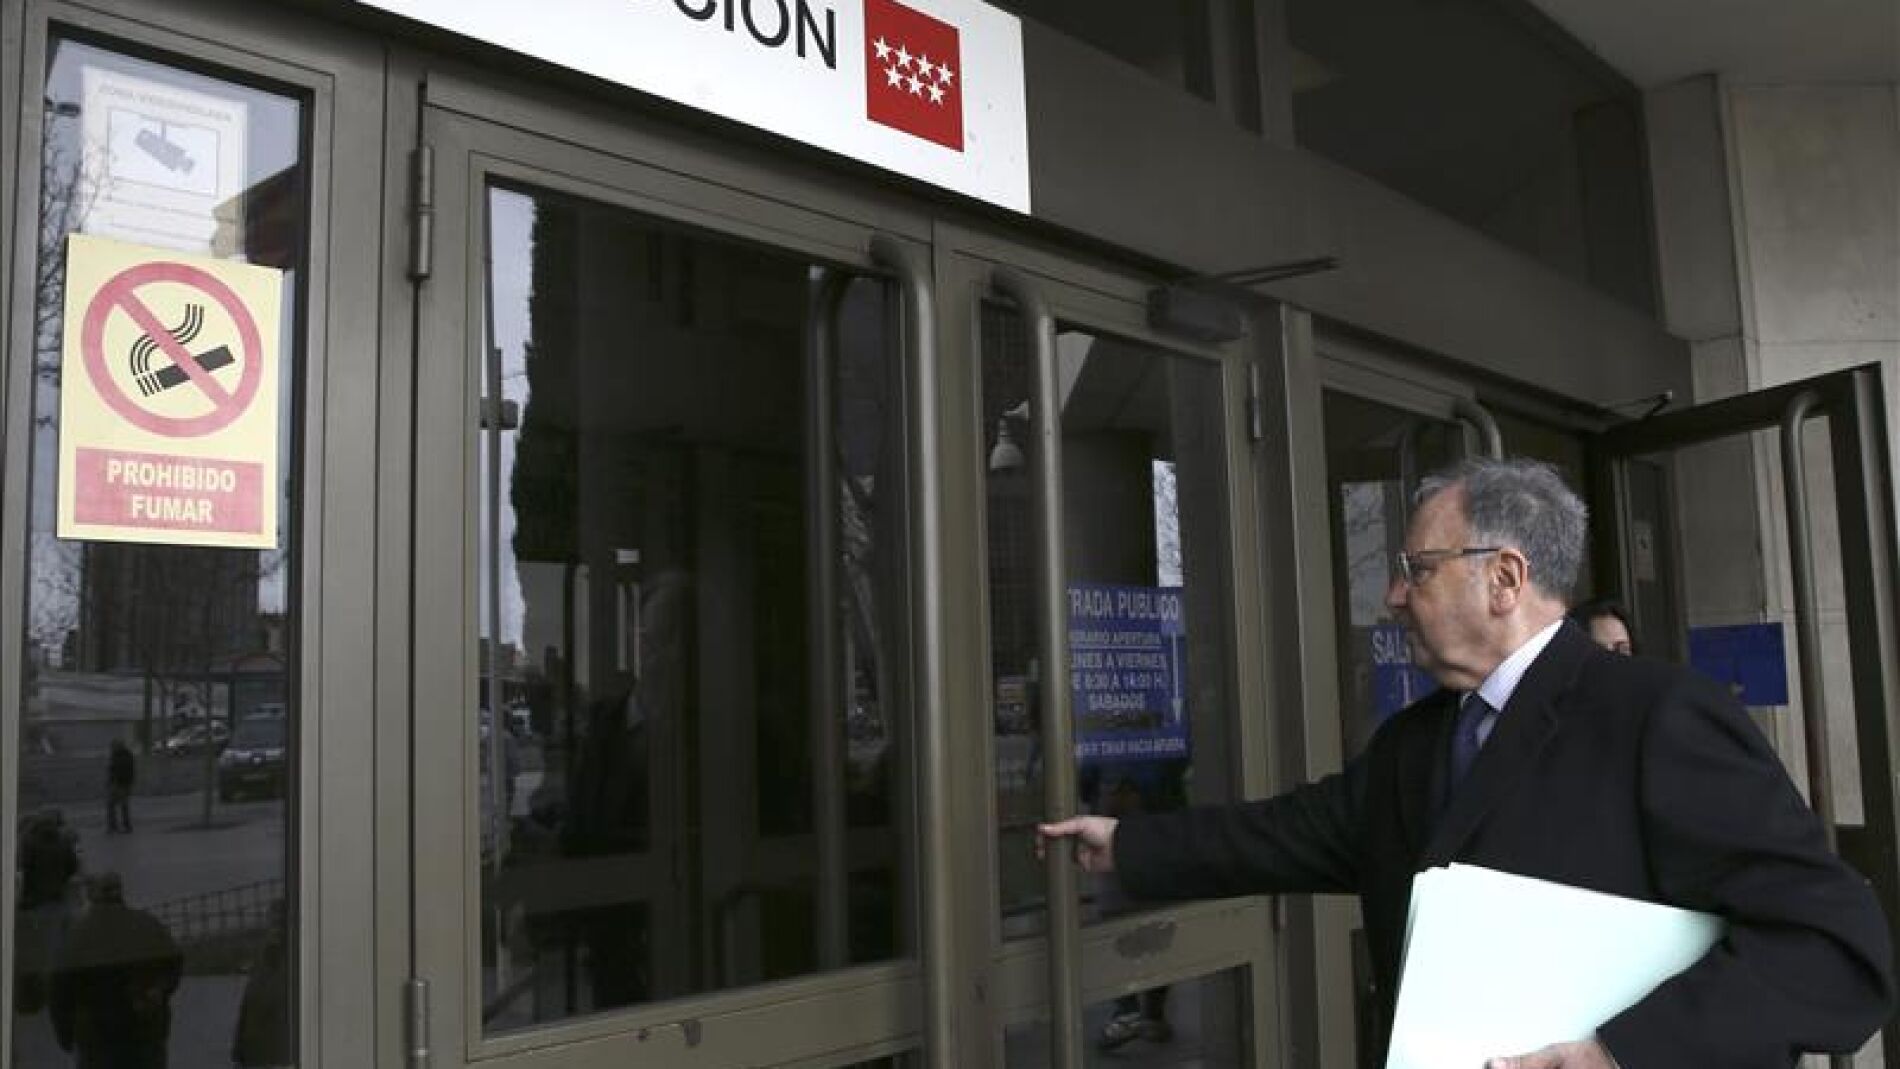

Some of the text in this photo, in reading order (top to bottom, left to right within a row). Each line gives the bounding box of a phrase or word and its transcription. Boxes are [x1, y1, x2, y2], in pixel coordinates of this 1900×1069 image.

[106, 459, 236, 493] PROHIBIDO
[131, 494, 213, 524] FUMAR
[1117, 591, 1180, 622] PUBLICO
[1117, 653, 1167, 669] VIERNES
